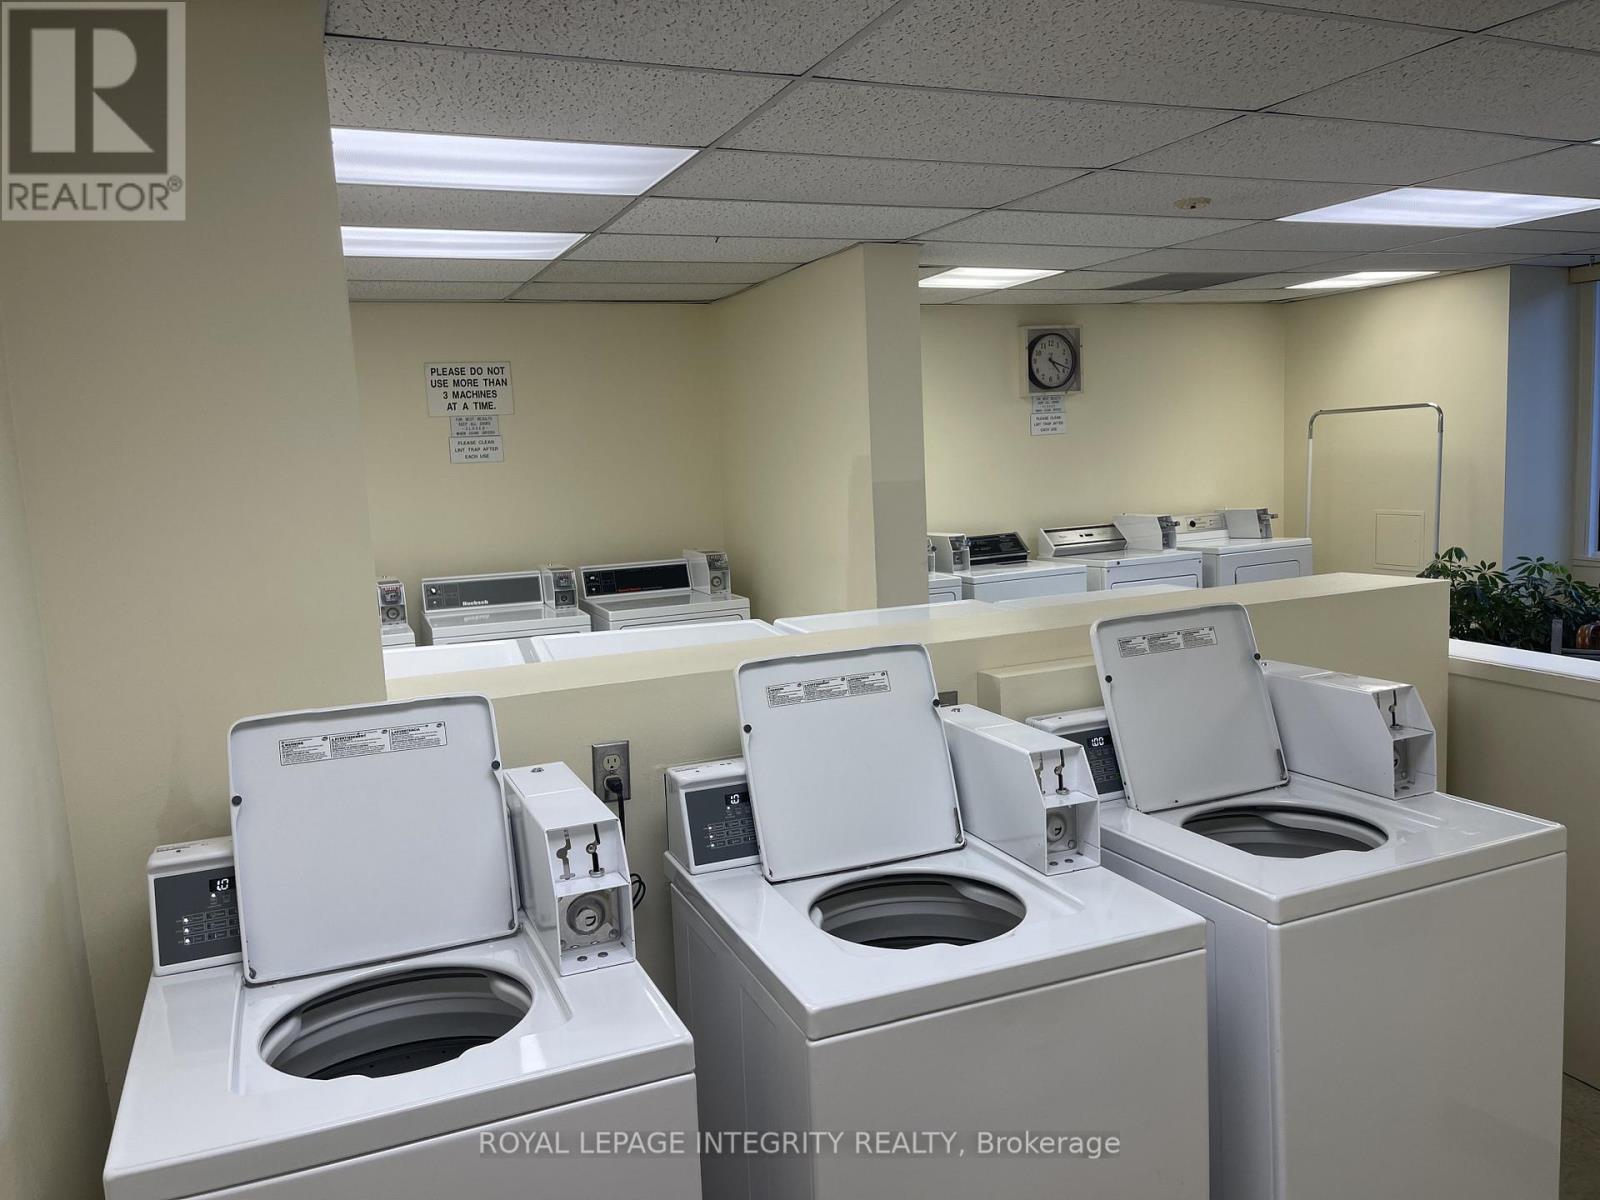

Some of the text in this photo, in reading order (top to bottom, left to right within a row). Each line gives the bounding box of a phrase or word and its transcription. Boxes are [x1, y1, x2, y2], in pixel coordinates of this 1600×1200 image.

[430, 366, 505, 376] PLEASE DO NOT
[430, 378, 508, 388] USE MORE THAN
[443, 390, 498, 400] 3 MACHINES
[447, 402, 496, 411] AT A TIME.
